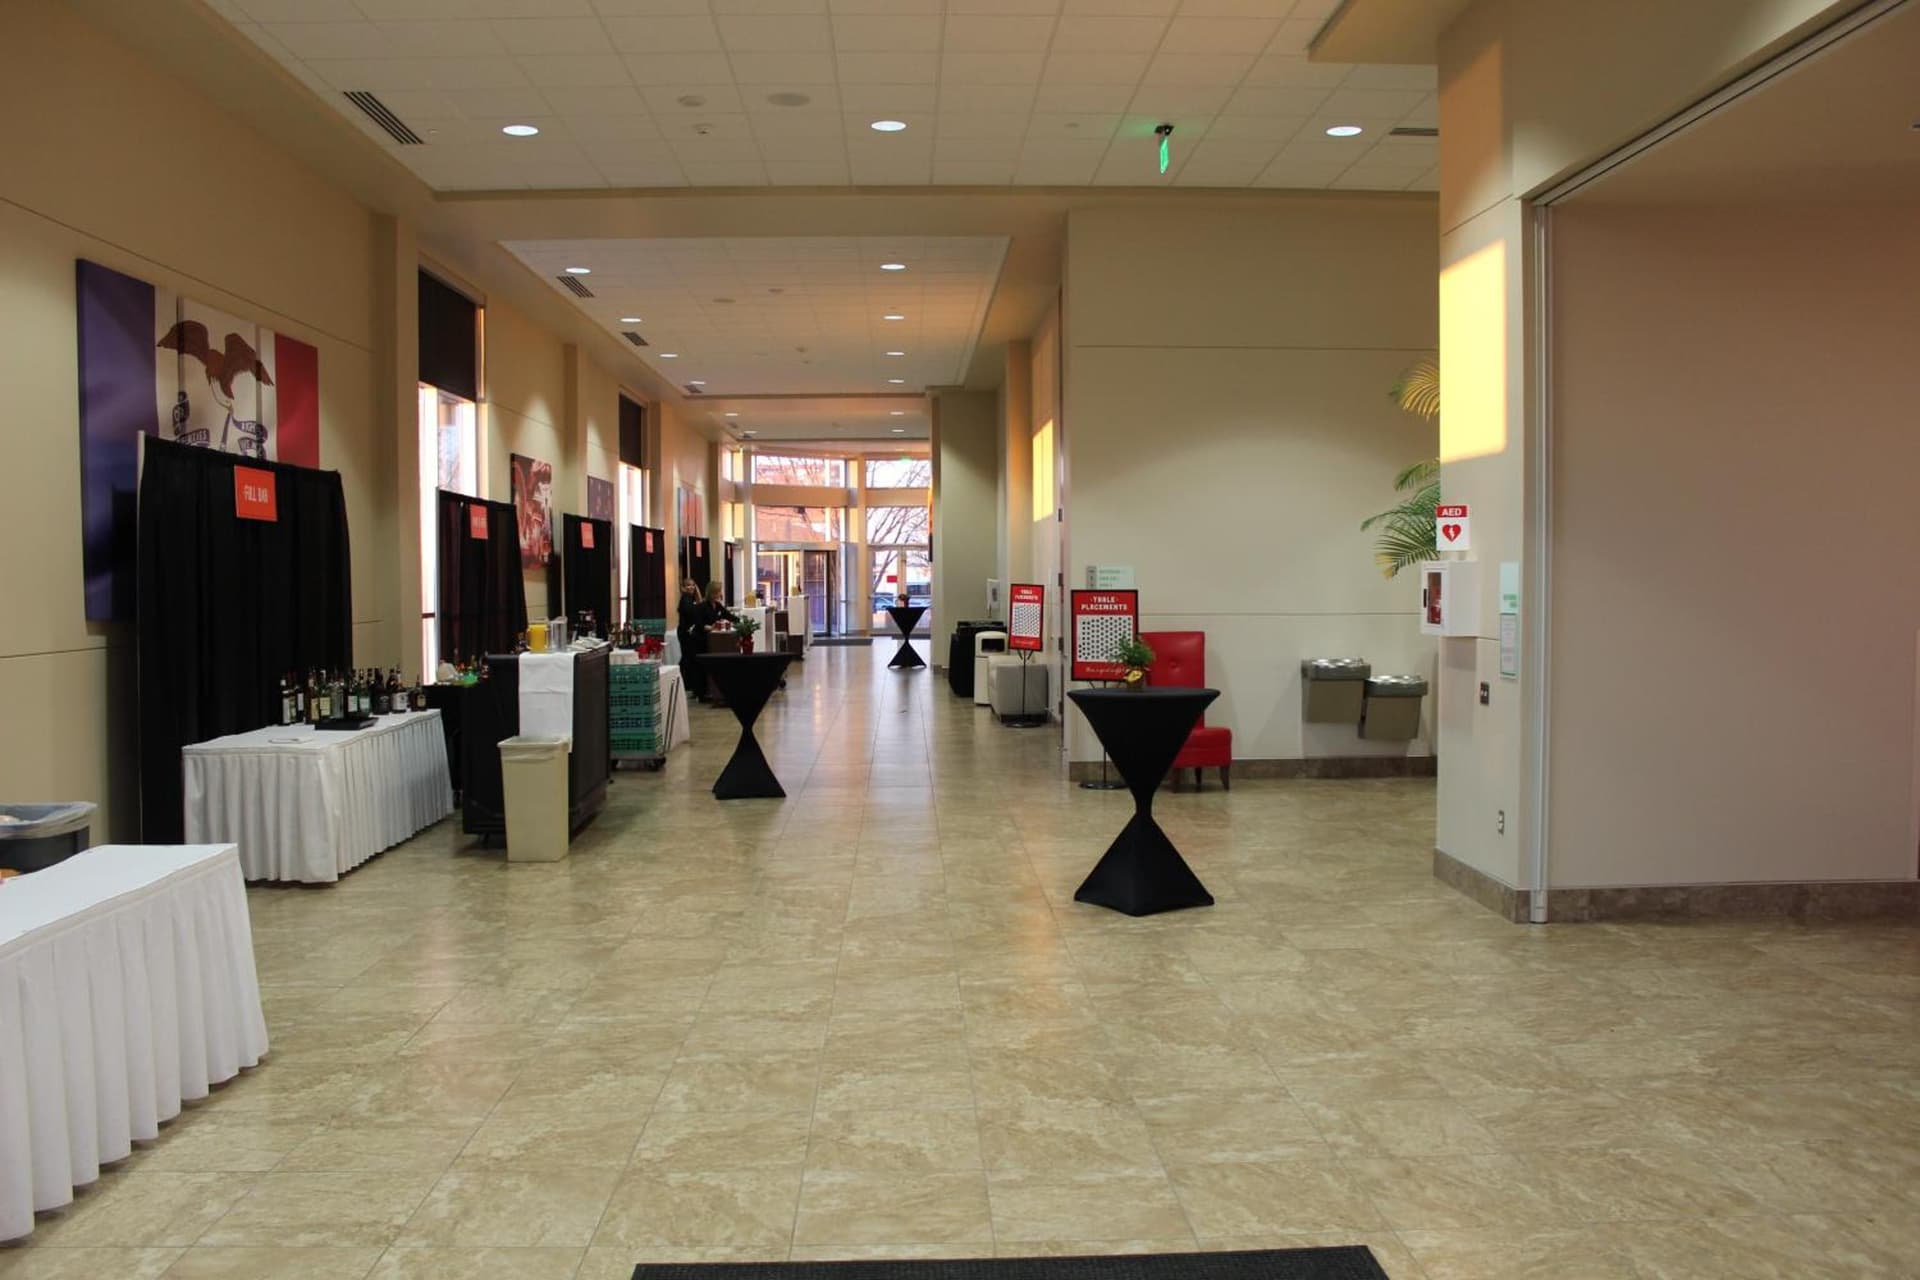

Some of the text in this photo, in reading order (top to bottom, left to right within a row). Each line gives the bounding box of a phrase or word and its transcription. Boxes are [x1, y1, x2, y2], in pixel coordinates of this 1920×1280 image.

[1441, 507, 1462, 517] AED
[1092, 595, 1116, 603] TABLE
[1080, 603, 1128, 611] PLACEMENTS
